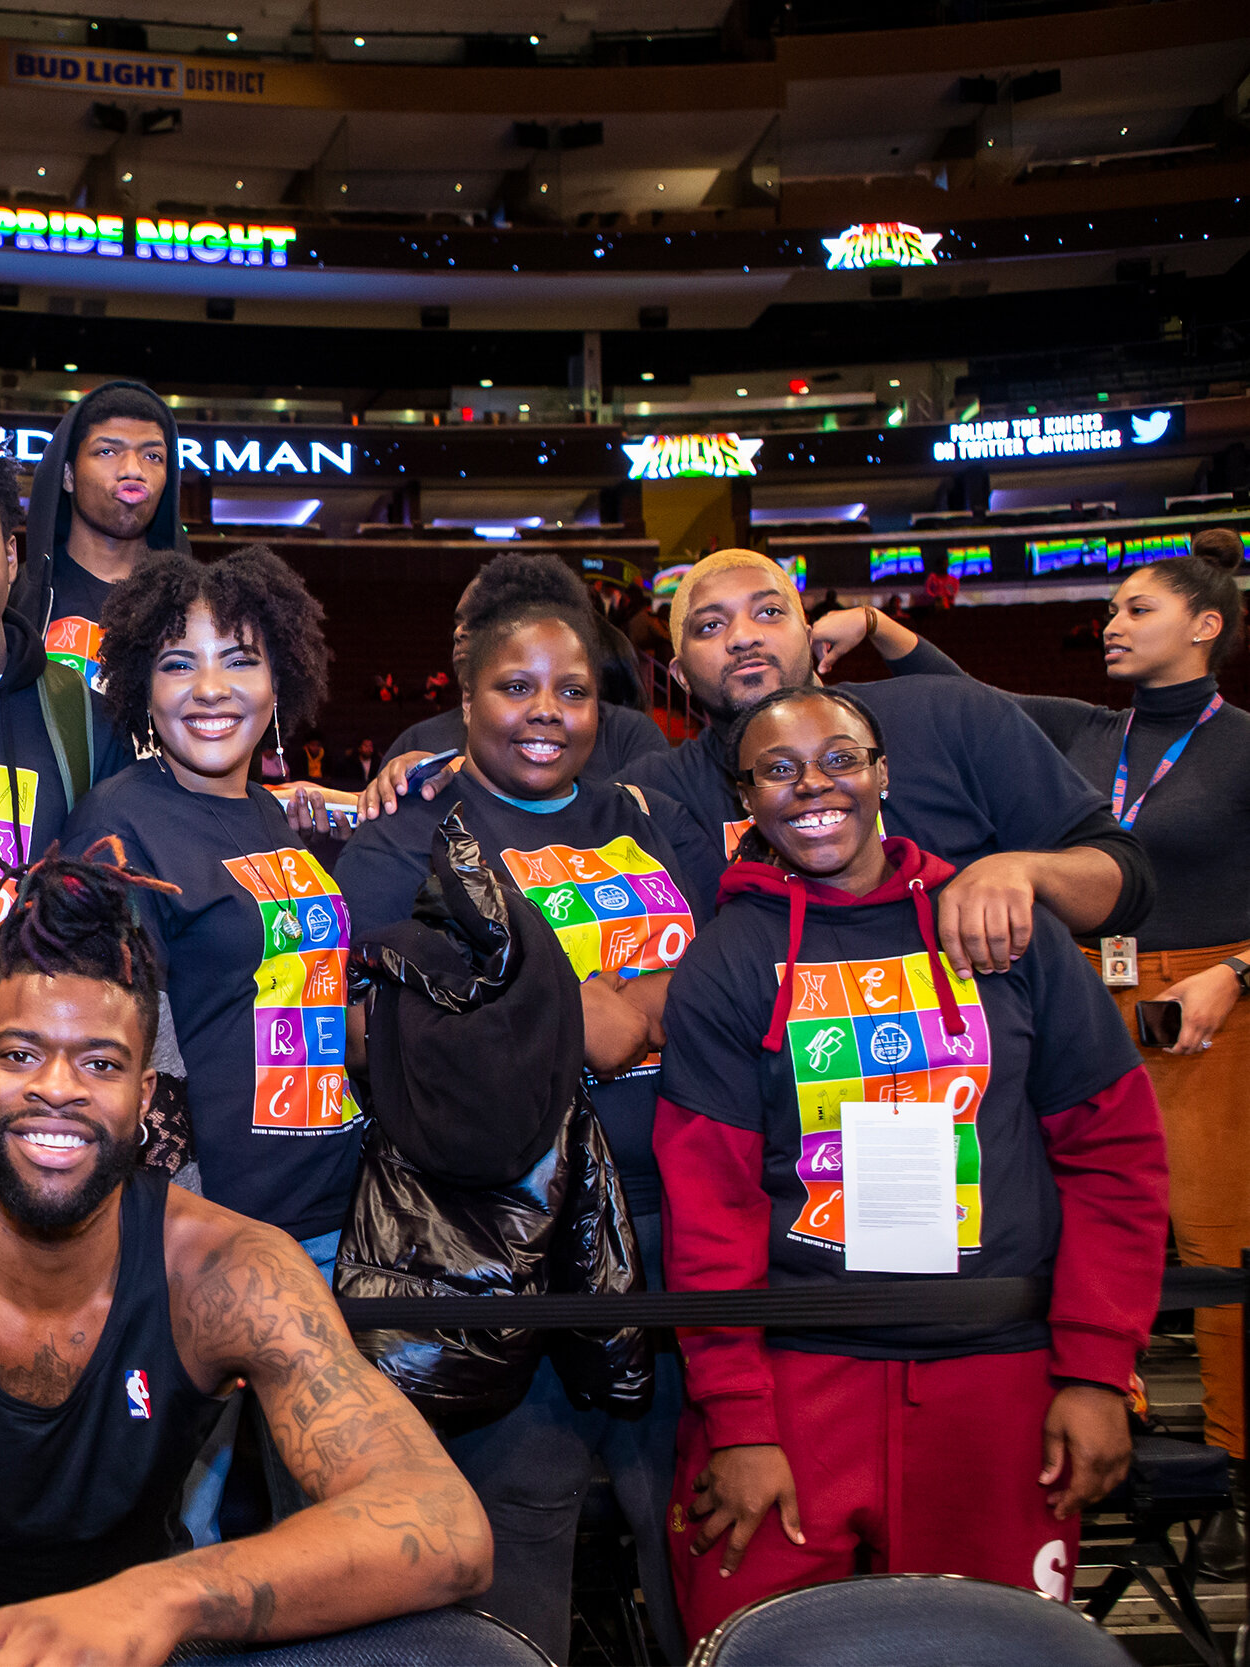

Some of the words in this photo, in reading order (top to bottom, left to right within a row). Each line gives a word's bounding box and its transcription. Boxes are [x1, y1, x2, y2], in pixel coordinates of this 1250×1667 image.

[16, 54, 80, 80] BUD
[86, 61, 174, 88] LIGHT
[185, 68, 265, 94] DISTRICT
[134, 216, 296, 267] NIGHT
[835, 228, 930, 268] KNICKS
[934, 441, 956, 461] ON
[958, 437, 1025, 460] TWITTER
[1026, 428, 1122, 456] @NYKNICKS
[950, 421, 1009, 442] FOLLOW
[1011, 418, 1040, 438] THE
[1044, 413, 1103, 436] KNICKS
[635, 434, 747, 479] KNICKS
[131, 1408, 146, 1417] NBA
